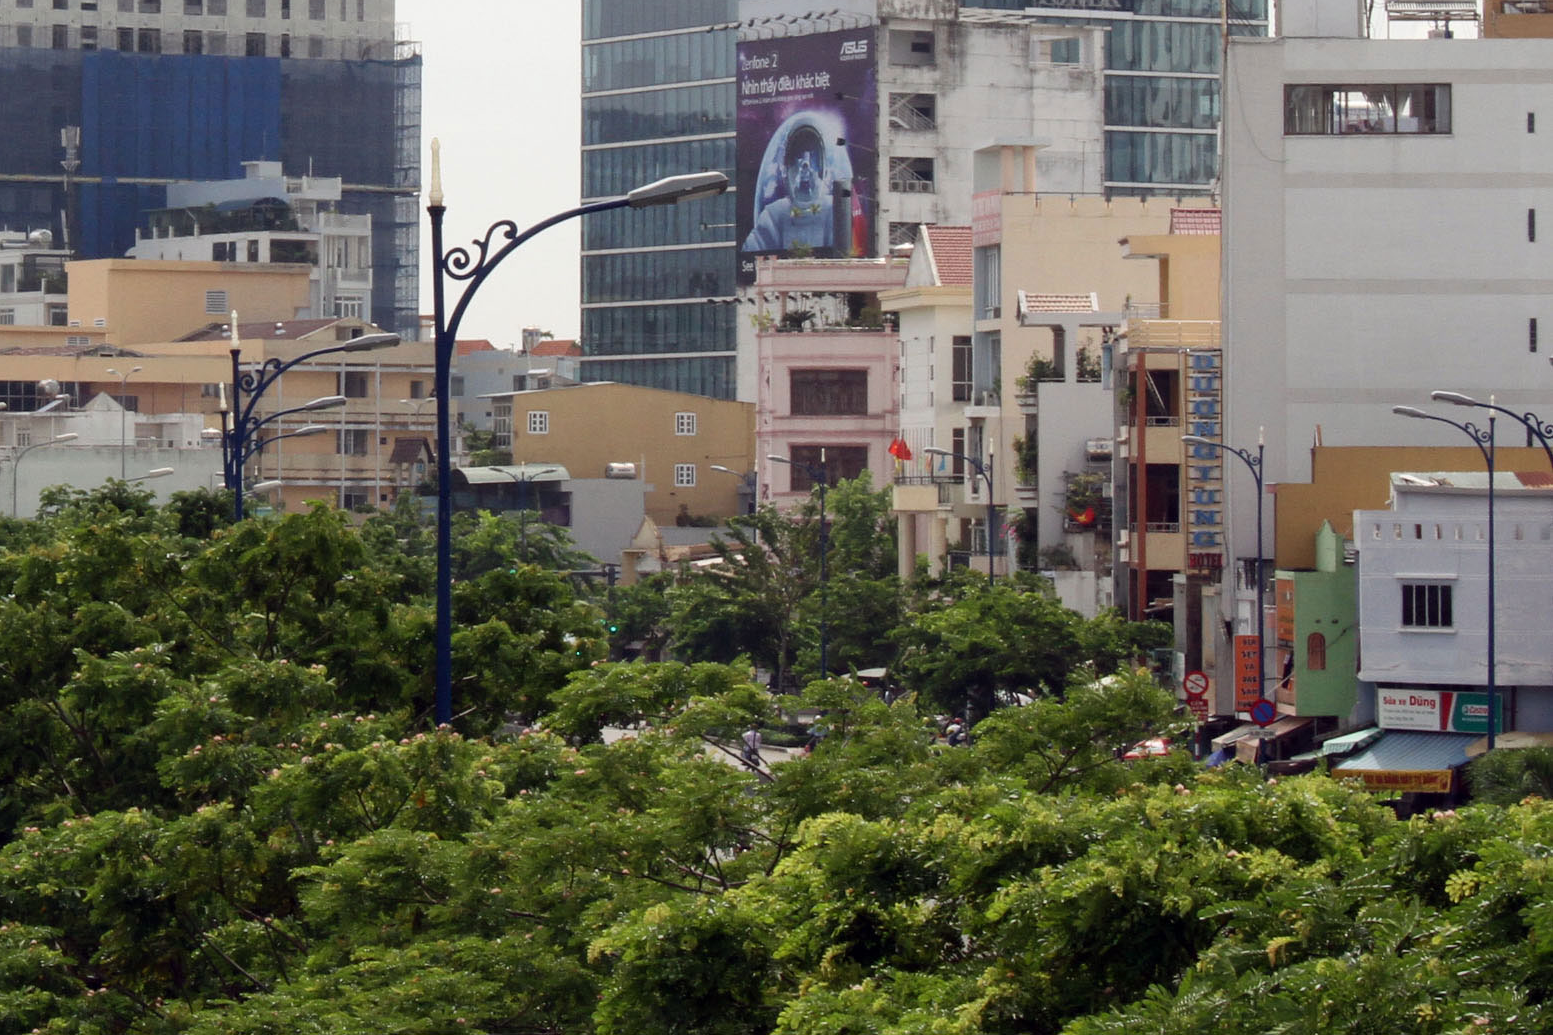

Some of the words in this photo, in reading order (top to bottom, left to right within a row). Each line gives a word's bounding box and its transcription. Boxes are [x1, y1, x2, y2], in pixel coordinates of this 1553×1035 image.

[840, 40, 868, 55] ASUS
[771, 53, 778, 68] 2
[1409, 694, 1437, 710] Dũng
